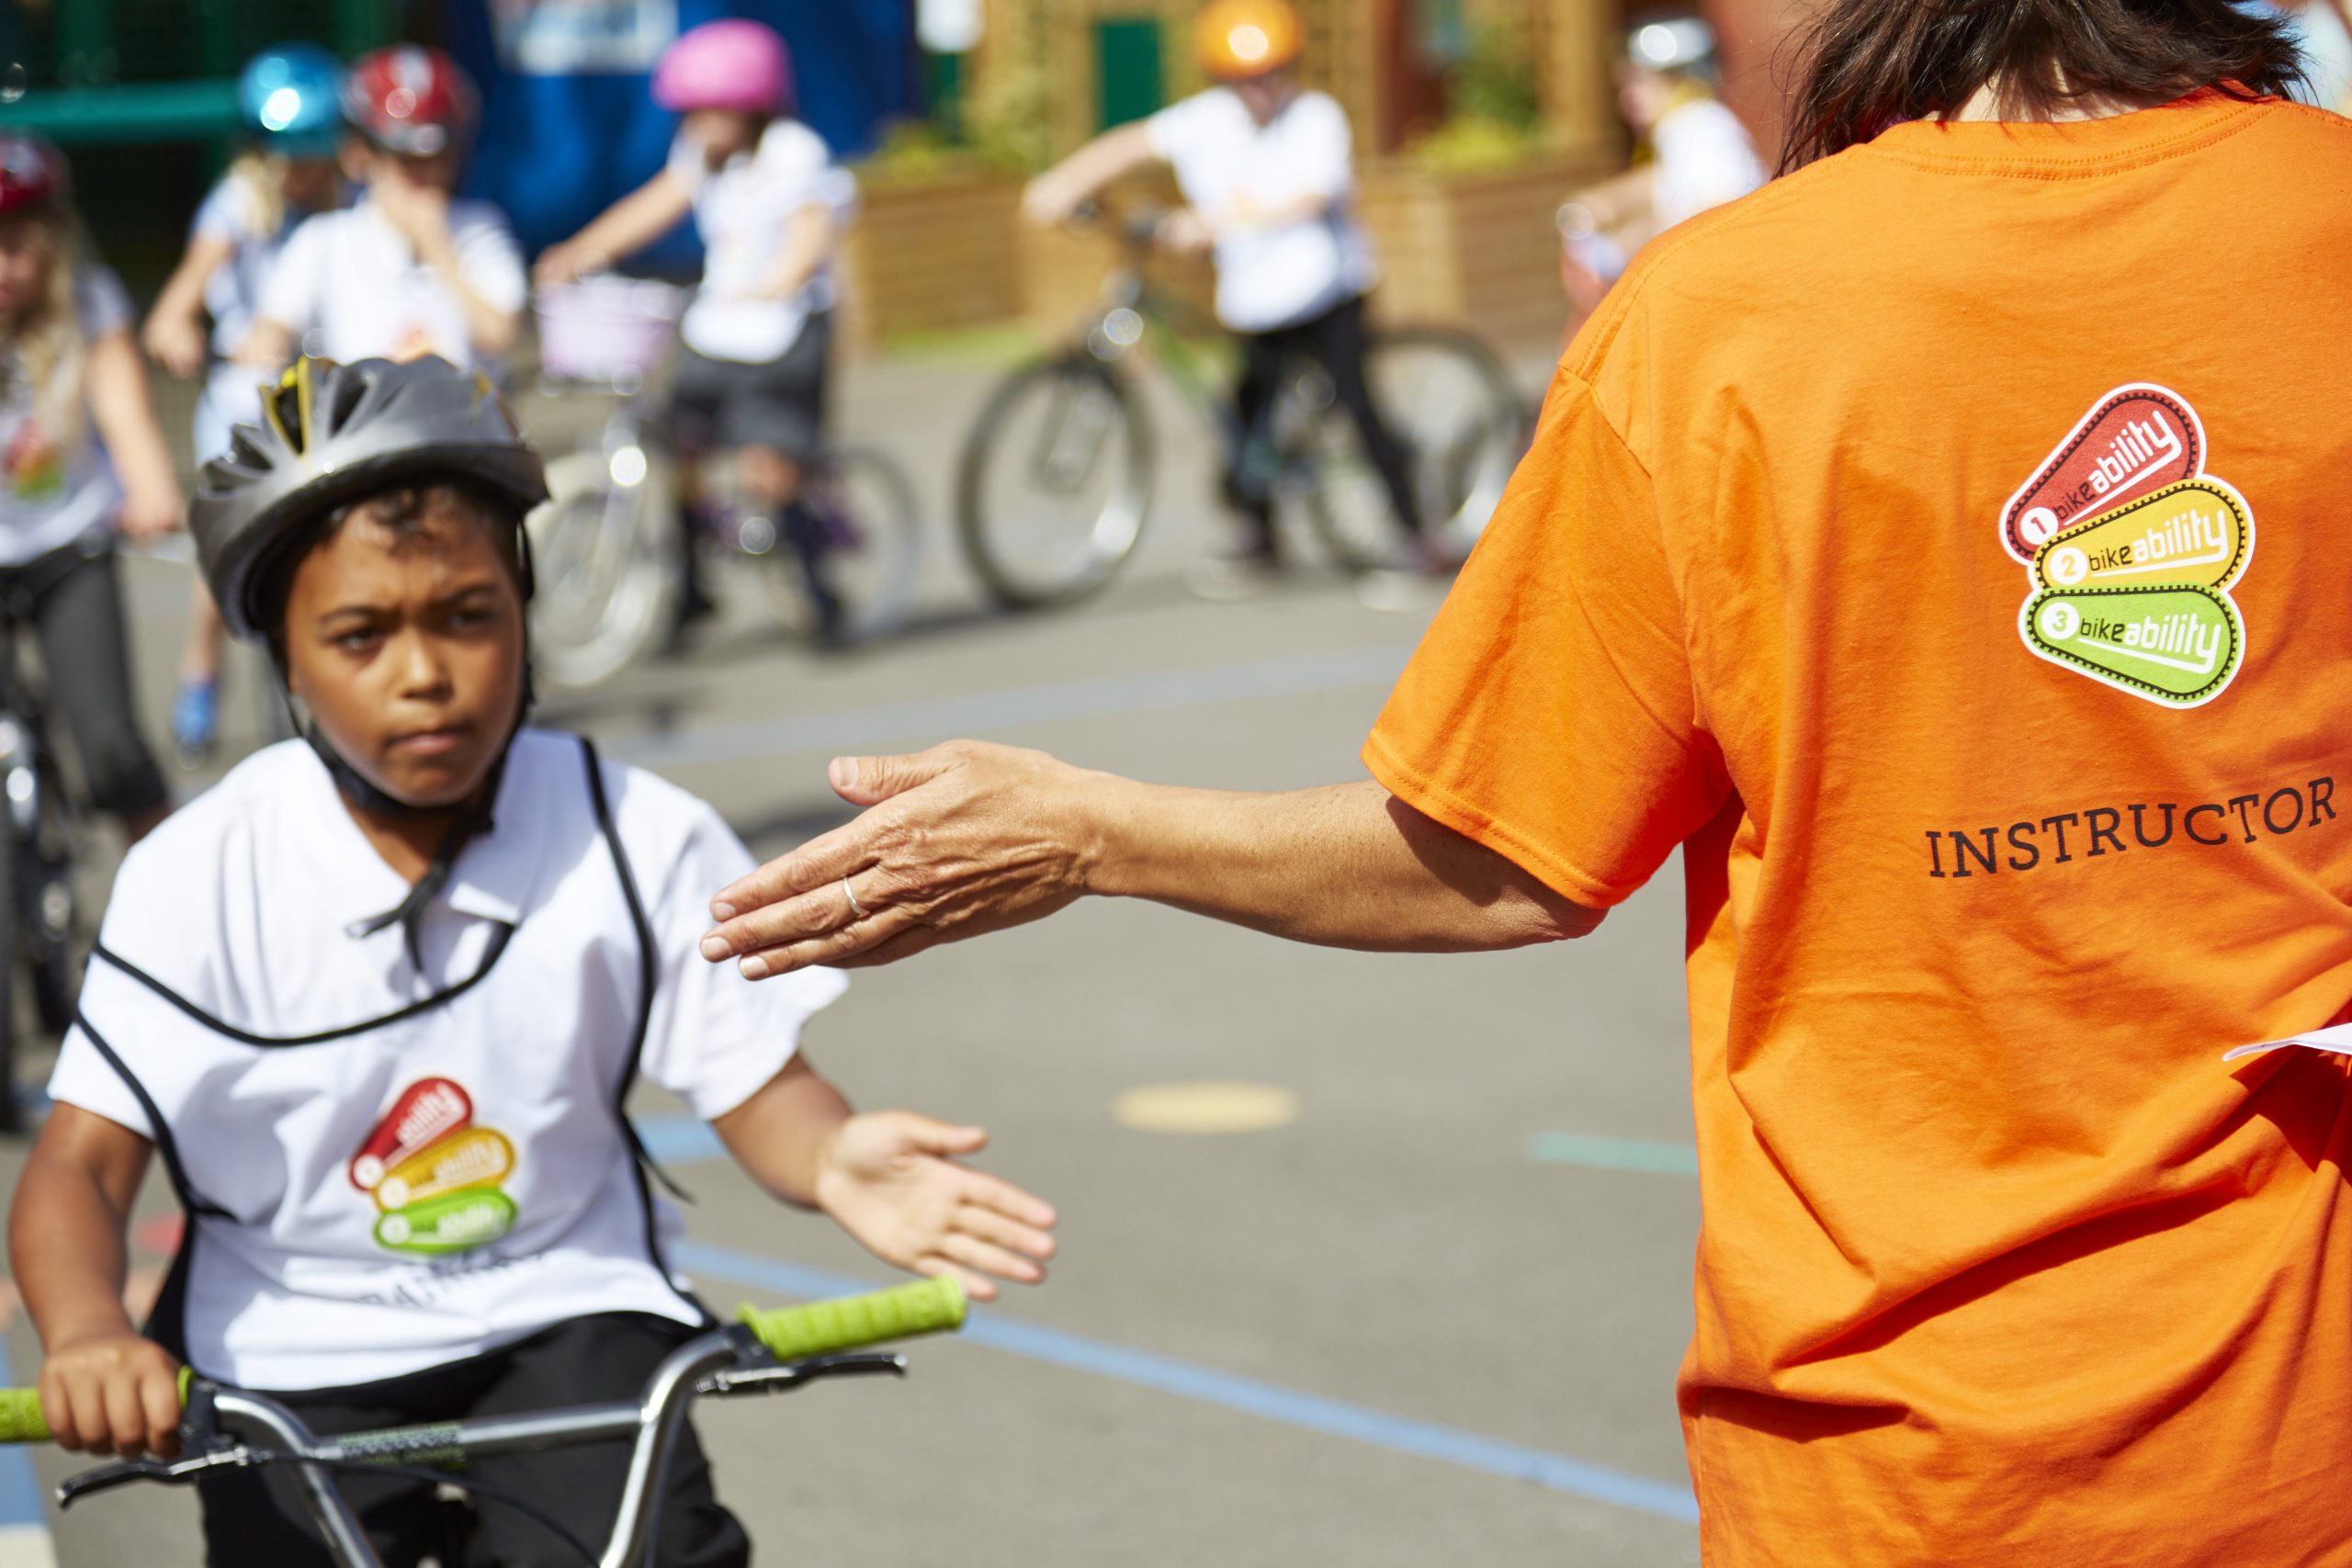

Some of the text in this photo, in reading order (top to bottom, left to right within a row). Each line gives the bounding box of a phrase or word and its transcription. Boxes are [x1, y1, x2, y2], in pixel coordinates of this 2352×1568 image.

[2030, 410, 2182, 535] 1 bikeability
[2060, 509, 2228, 577] 2 bikeability
[2052, 610, 2221, 673] 3 bikeability
[1926, 776, 2336, 878] INSTRUCTOR
